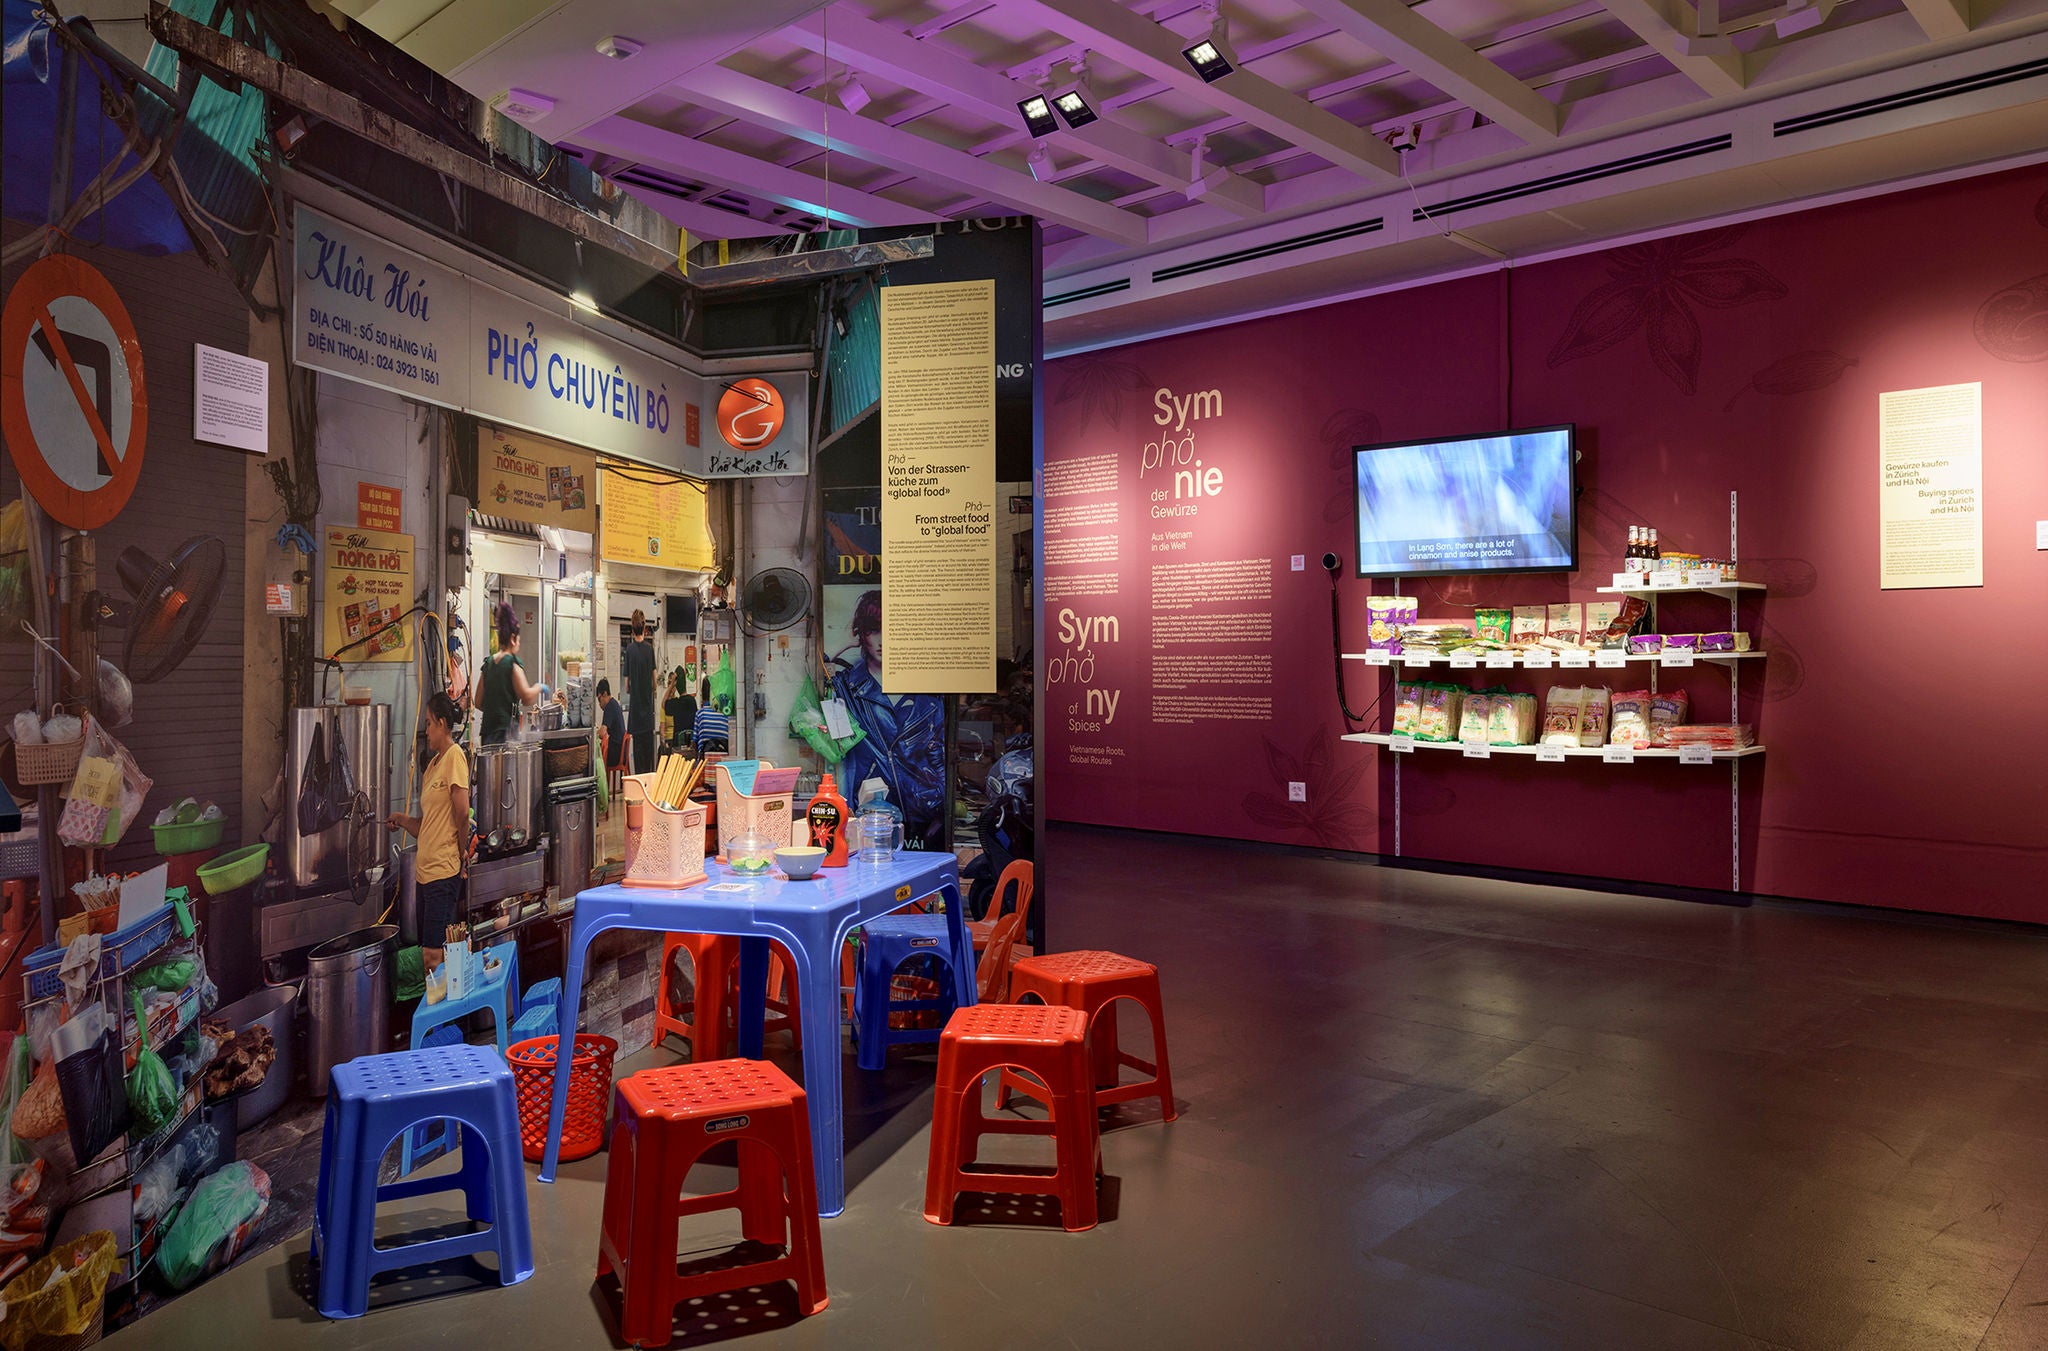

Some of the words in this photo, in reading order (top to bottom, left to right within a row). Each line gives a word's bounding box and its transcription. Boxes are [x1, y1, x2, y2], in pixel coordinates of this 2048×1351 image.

[310, 308, 329, 328] ĐỊA
[360, 323, 374, 342] SỐ
[376, 330, 387, 346] 50
[390, 334, 418, 356] HÀNG
[421, 343, 436, 363] VẢI
[308, 332, 335, 354] ĐIỆN
[338, 342, 368, 366] THOẠI
[377, 355, 394, 371] 024
[396, 360, 418, 379] 3923
[421, 368, 440, 386] 1561
[488, 322, 538, 390] PHỞ
[548, 353, 639, 424] CHUYÊN
[647, 383, 670, 433] BÒ
[1154, 388, 1222, 432] Sym
[1139, 428, 1194, 479] phở
[888, 466, 906, 475] Von
[908, 465, 924, 474] der
[926, 464, 970, 473] Strassen-
[1886, 463, 1920, 471] Gewürze
[1922, 460, 1949, 468] kaufen
[888, 477, 917, 486] küche
[919, 477, 938, 486] zum
[1151, 489, 1168, 502] der
[1175, 460, 1224, 499] nie
[888, 487, 921, 499] «global
[924, 487, 950, 496] food»
[1919, 490, 1946, 498] Buying
[1948, 488, 1974, 496] spices
[1151, 504, 1198, 519] Gewürze
[915, 514, 938, 524] From
[940, 514, 966, 523] street
[968, 513, 989, 522] food
[921, 527, 930, 535] to
[1152, 533, 1164, 541] Aus
[1165, 532, 1192, 540] Vietnam
[1171, 542, 1186, 550] Welt
[1409, 544, 1415, 552] In
[1455, 542, 1474, 550] there
[1507, 539, 1514, 547] of
[1459, 550, 1478, 558] anise
[1480, 549, 1514, 558] products.
[1058, 608, 1119, 650] Sym
[1046, 649, 1095, 691] phở
[1069, 702, 1078, 714] of
[1087, 689, 1120, 724] ny
[1069, 718, 1100, 733] Spices
[1070, 745, 1105, 754] Vietnamese
[1106, 746, 1125, 756] Roots,
[1070, 755, 1089, 763] Global
[1091, 756, 1112, 765] Routes
